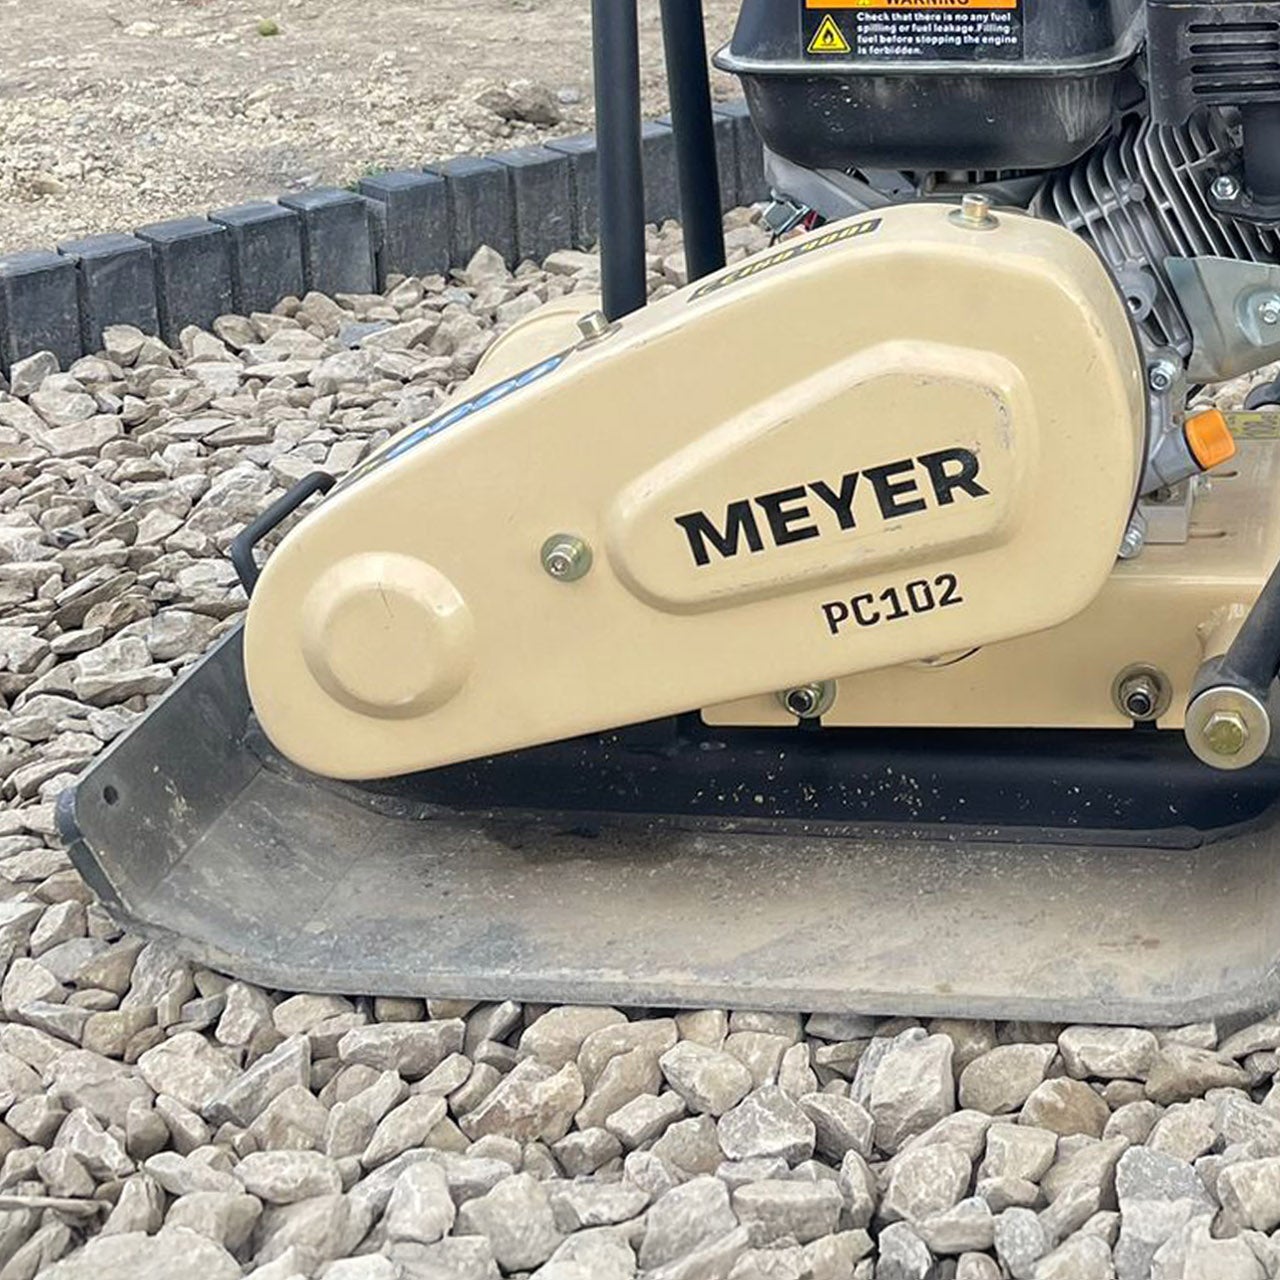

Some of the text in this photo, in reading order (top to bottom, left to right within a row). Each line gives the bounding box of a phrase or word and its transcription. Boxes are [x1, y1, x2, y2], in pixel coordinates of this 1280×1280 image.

[857, 11, 1011, 23] Check that there is no any fuel
[911, 23, 932, 32] fuel
[857, 34, 1018, 46] fuel before stopping the engine
[857, 45, 924, 55] is forbidden.
[674, 447, 990, 567] MEYER
[821, 573, 963, 635] PC102
